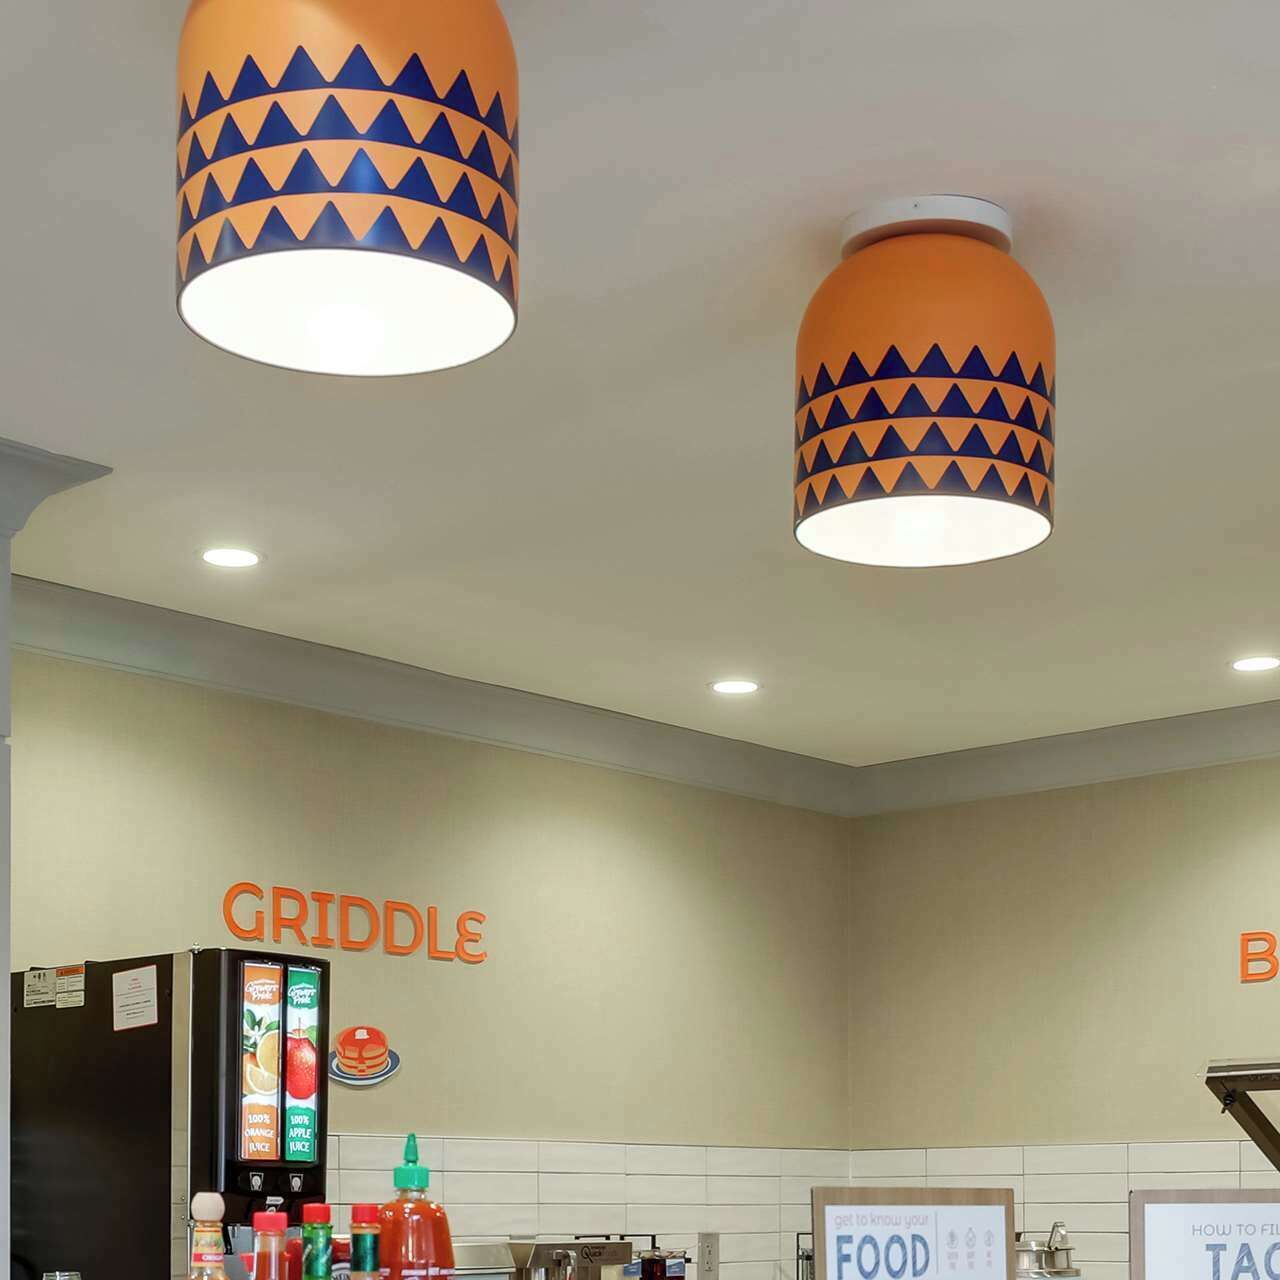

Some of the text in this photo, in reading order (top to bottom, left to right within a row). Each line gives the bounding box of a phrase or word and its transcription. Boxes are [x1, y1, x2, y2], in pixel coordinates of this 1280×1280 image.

[223, 881, 488, 964] GRIDDLE
[248, 1114, 272, 1124] 100%
[290, 1115, 309, 1125] 100%
[244, 1128, 274, 1138] ORANGE
[289, 1128, 312, 1139] APPLE
[249, 1142, 270, 1152] JUICE
[290, 1142, 310, 1154] JUICE
[834, 1213, 929, 1230] get to know your
[1192, 1223, 1233, 1237] HOW
[1236, 1223, 1257, 1236] TO
[836, 1233, 930, 1280] FOOD
